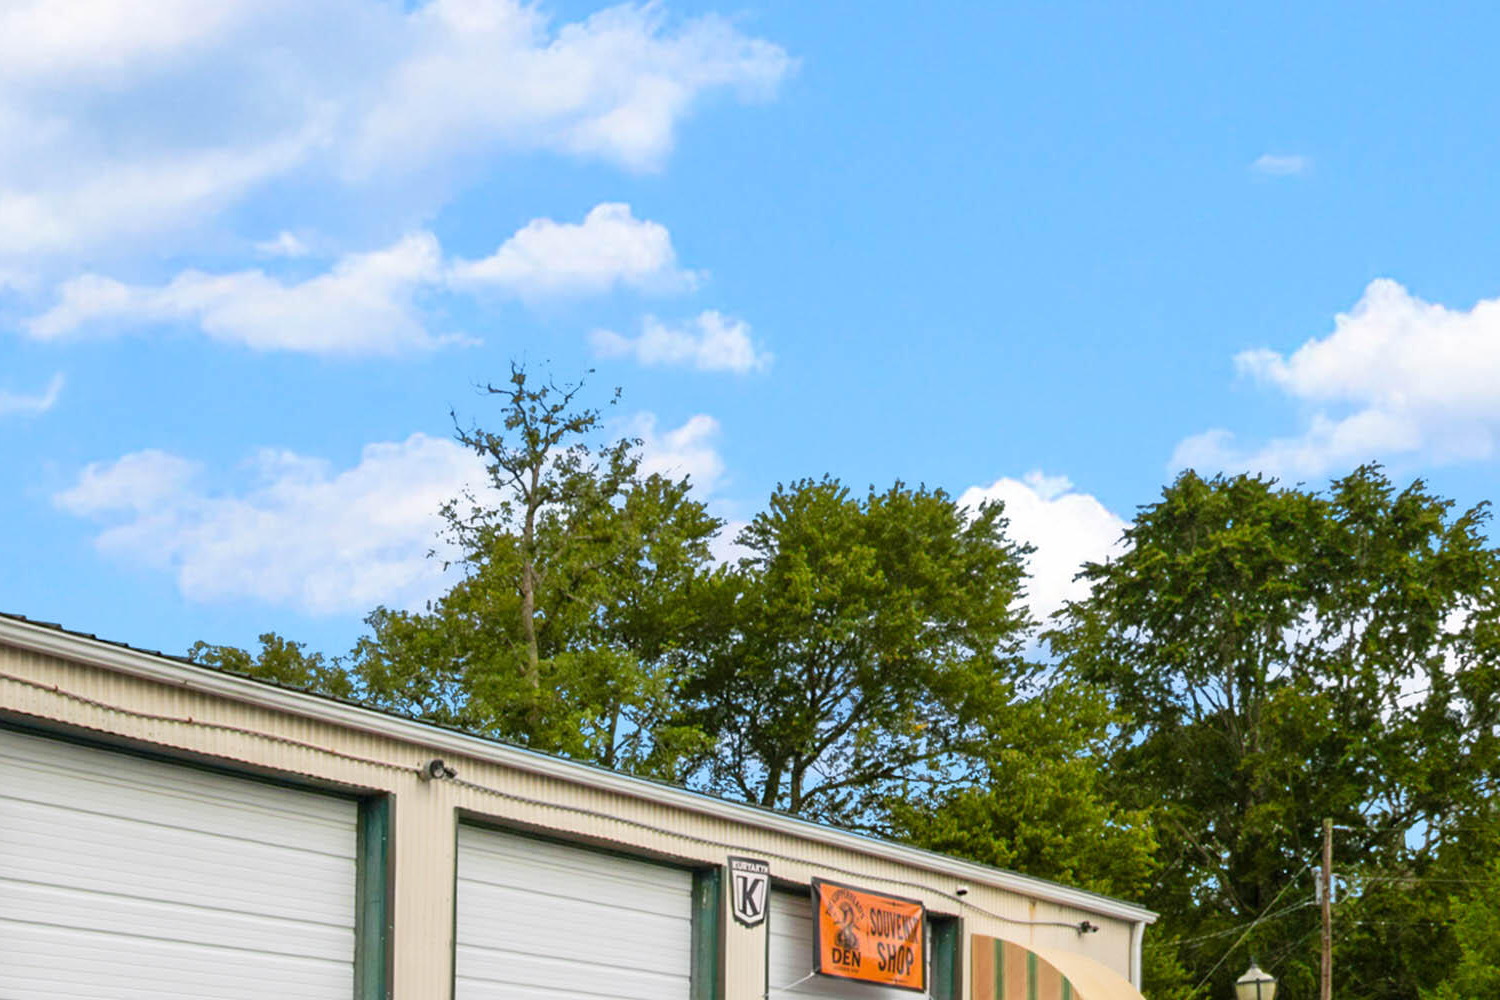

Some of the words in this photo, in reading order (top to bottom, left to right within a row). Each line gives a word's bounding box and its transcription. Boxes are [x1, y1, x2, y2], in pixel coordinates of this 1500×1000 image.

[736, 875, 764, 917] K
[869, 907, 919, 944] SOUVENIR
[832, 948, 861, 968] DEN
[877, 941, 914, 976] SHOP
